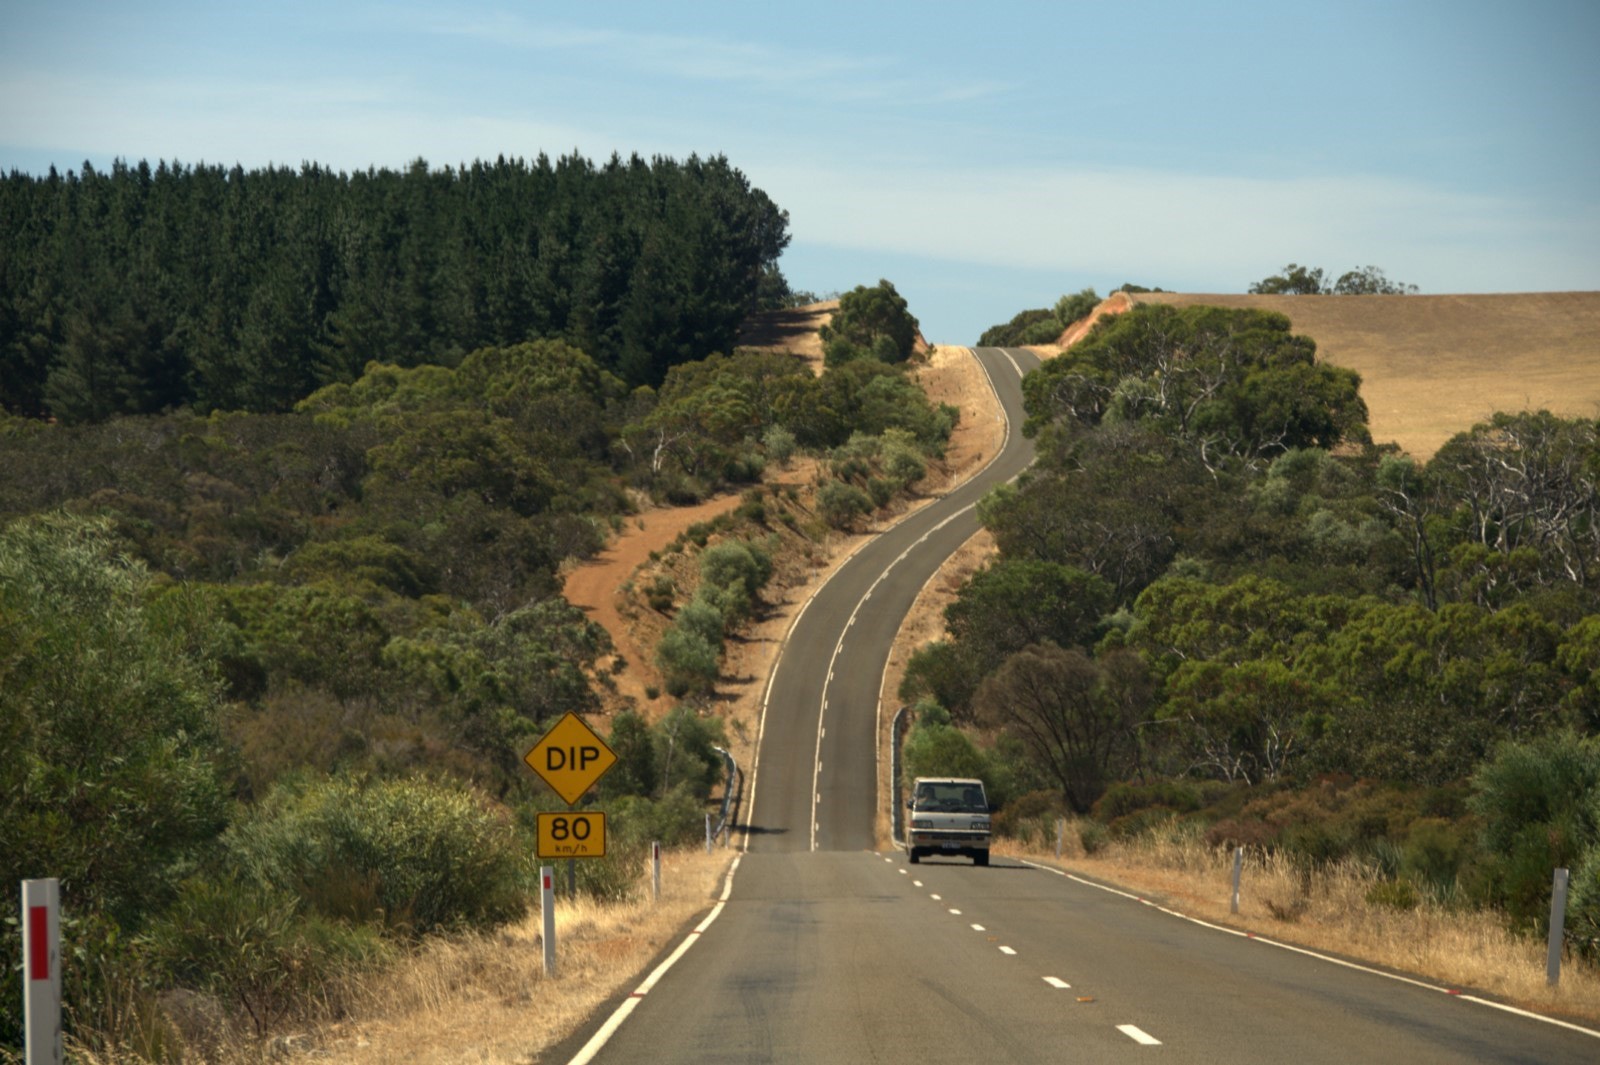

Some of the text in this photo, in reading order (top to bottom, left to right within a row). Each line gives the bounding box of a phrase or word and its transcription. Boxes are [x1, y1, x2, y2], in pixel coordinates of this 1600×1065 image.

[547, 747, 599, 770] DIP
[551, 817, 591, 841] 80
[555, 844, 588, 855] km/h
